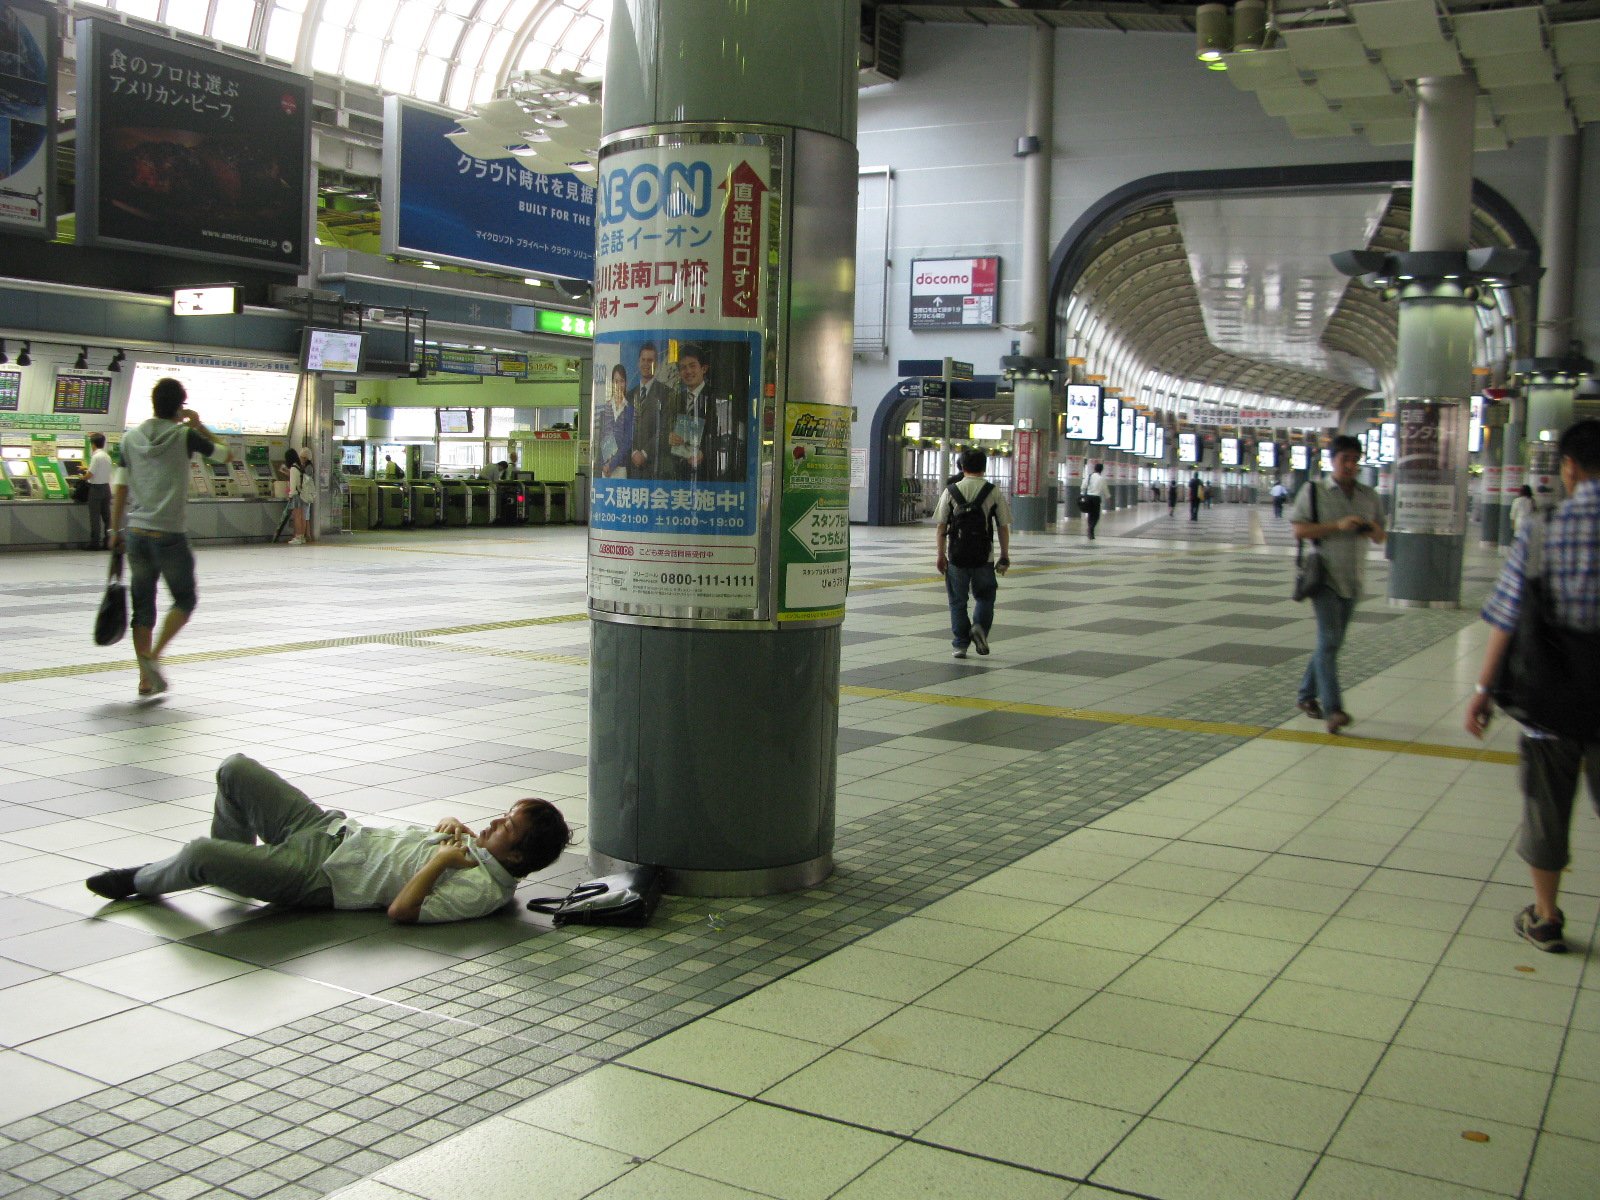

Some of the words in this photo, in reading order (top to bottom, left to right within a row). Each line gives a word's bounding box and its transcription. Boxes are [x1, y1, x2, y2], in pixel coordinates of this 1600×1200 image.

[110, 49, 239, 97] 食のプロは選ぶ
[519, 201, 547, 216] BUILT
[551, 208, 569, 221] FOR
[572, 213, 591, 226] THE
[475, 230, 514, 245] マイクロソフト
[551, 245, 571, 256] クラウド
[916, 273, 969, 285] docomo
[541, 431, 562, 439] KIOSK
[616, 546, 634, 557] KIDS
[660, 572, 754, 587] 0800-111-1111
